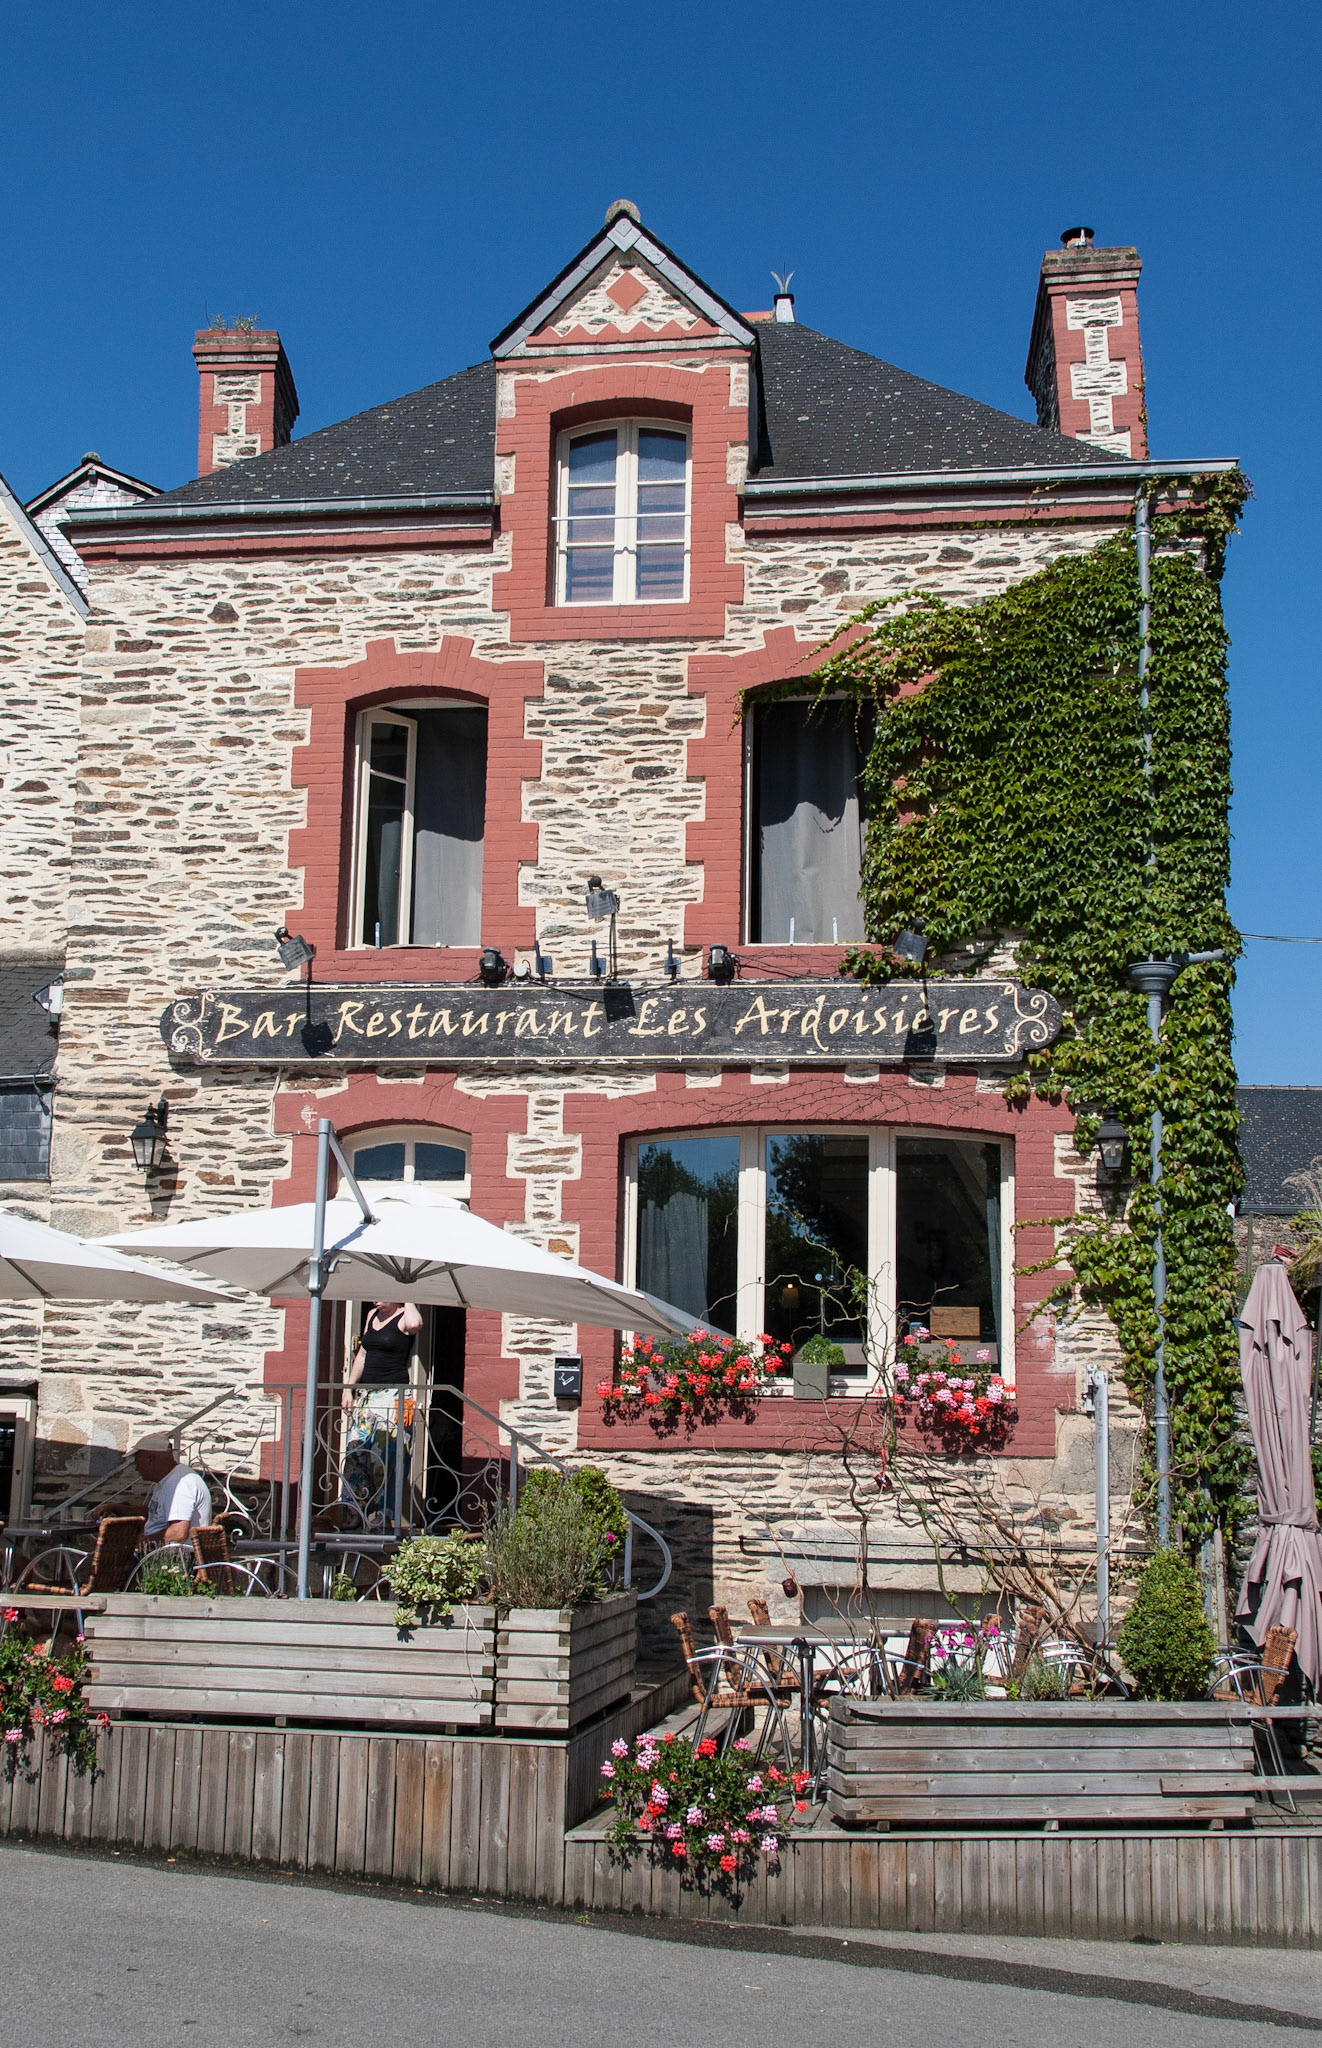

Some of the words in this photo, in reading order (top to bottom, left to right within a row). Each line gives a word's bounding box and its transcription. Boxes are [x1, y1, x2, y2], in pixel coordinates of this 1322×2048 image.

[215, 1000, 307, 1044] Bar
[331, 1000, 604, 1045] Restaurant
[627, 997, 707, 1036] Les
[734, 992, 1000, 1053] Ardoisières
